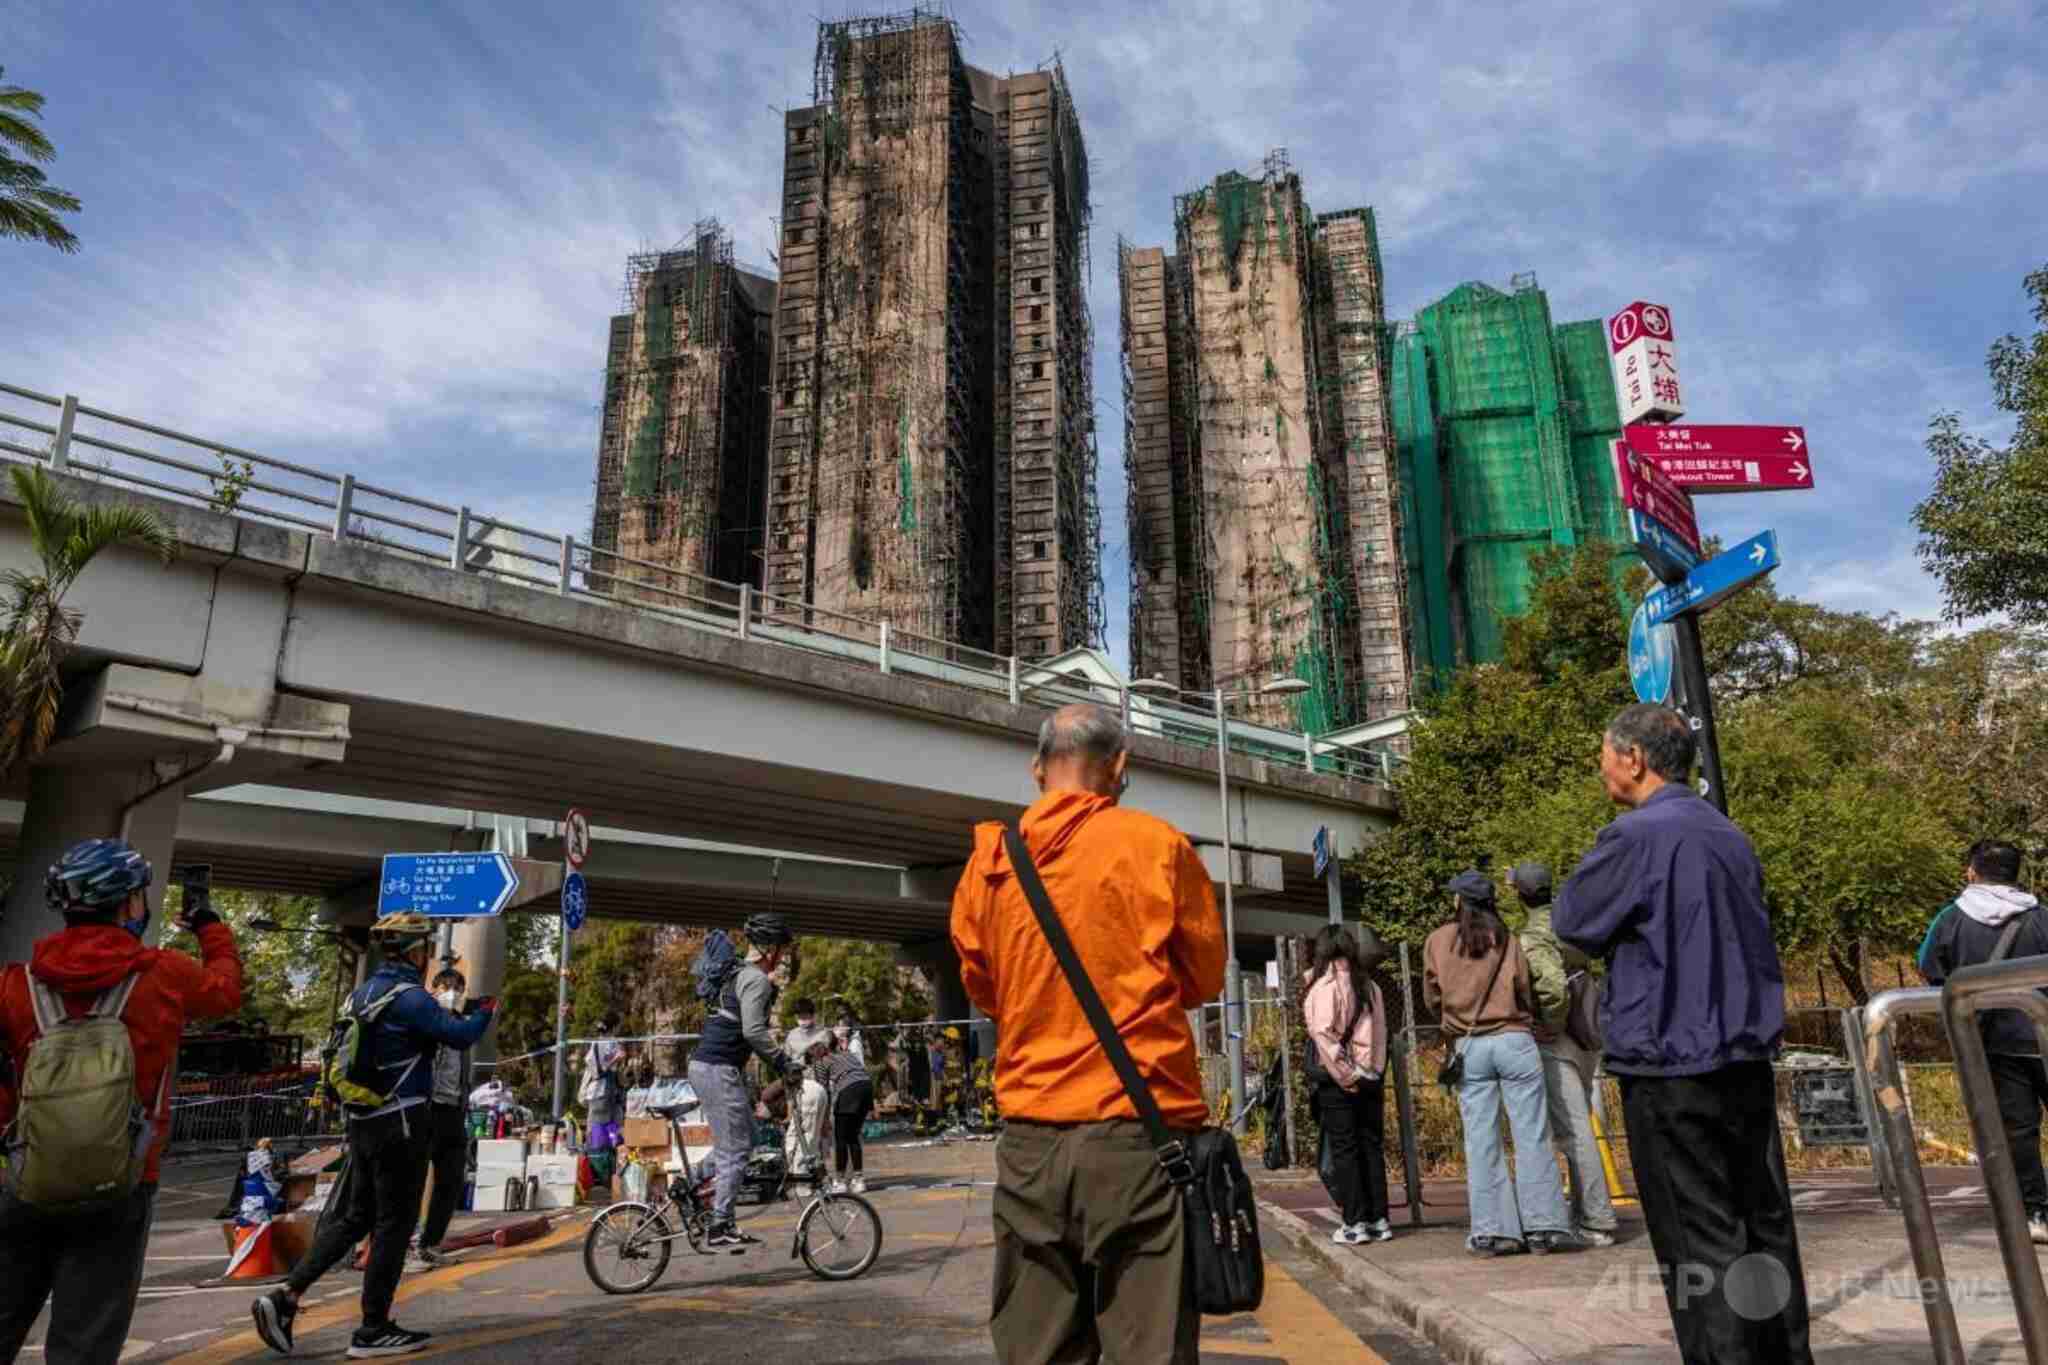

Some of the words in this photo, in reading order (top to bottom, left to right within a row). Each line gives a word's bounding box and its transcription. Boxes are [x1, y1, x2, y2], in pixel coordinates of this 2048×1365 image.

[1648, 343, 1680, 405] 大埔
[1658, 441, 1673, 449] Tai
[1674, 441, 1692, 450] Mei
[1693, 441, 1712, 450] Tuk
[1704, 472, 1734, 481] Tower
